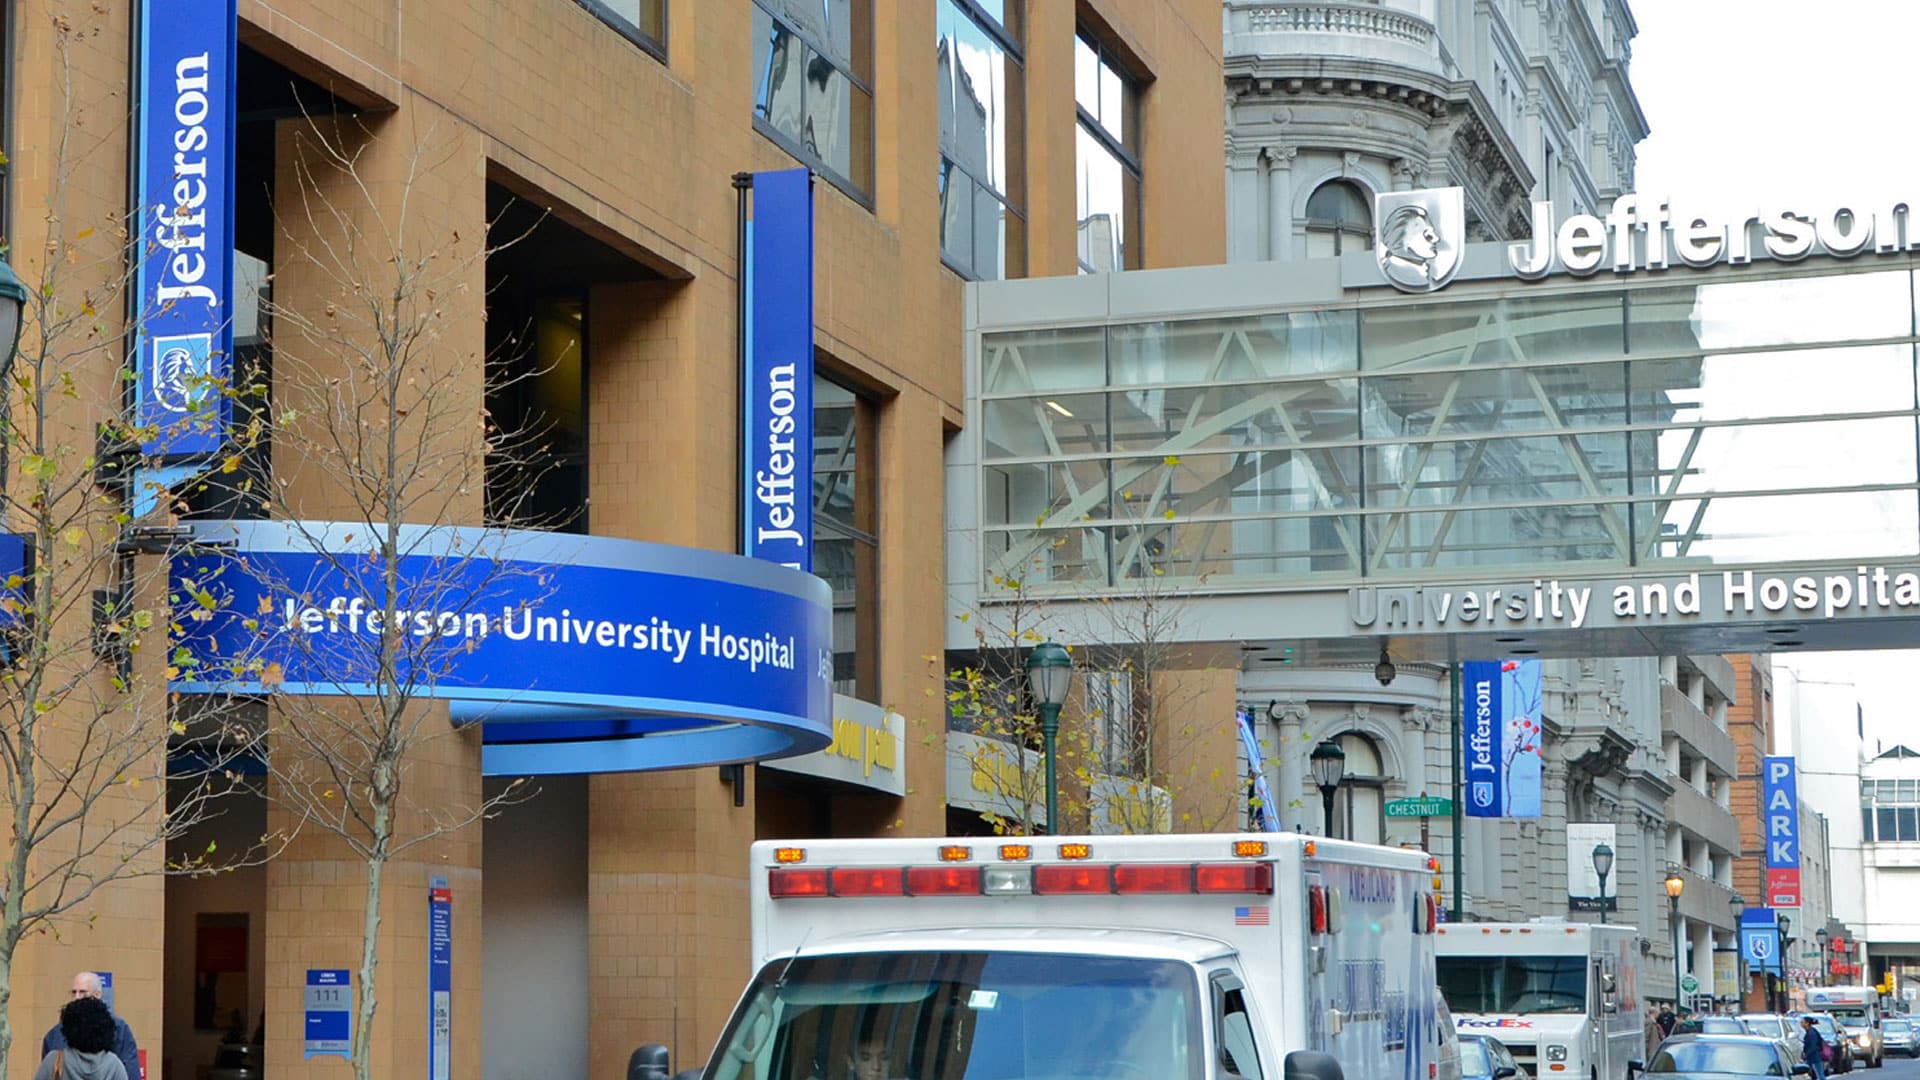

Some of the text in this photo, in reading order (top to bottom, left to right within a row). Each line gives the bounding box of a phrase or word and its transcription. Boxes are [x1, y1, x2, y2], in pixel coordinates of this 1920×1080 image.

[156, 51, 217, 307] Jefferson
[1507, 193, 1920, 280] Jefferson
[756, 362, 804, 547] Jefferson
[1351, 566, 1920, 628] University and Hospita
[503, 605, 692, 664] University
[701, 623, 795, 673] Hospital
[864, 715, 896, 778] pain
[1470, 680, 1496, 774] Jefferson
[1388, 803, 1441, 816] CHESTNUT
[1769, 762, 1794, 863] PARK
[313, 989, 339, 1001] 111
[1457, 1018, 1534, 1029] FedEx
